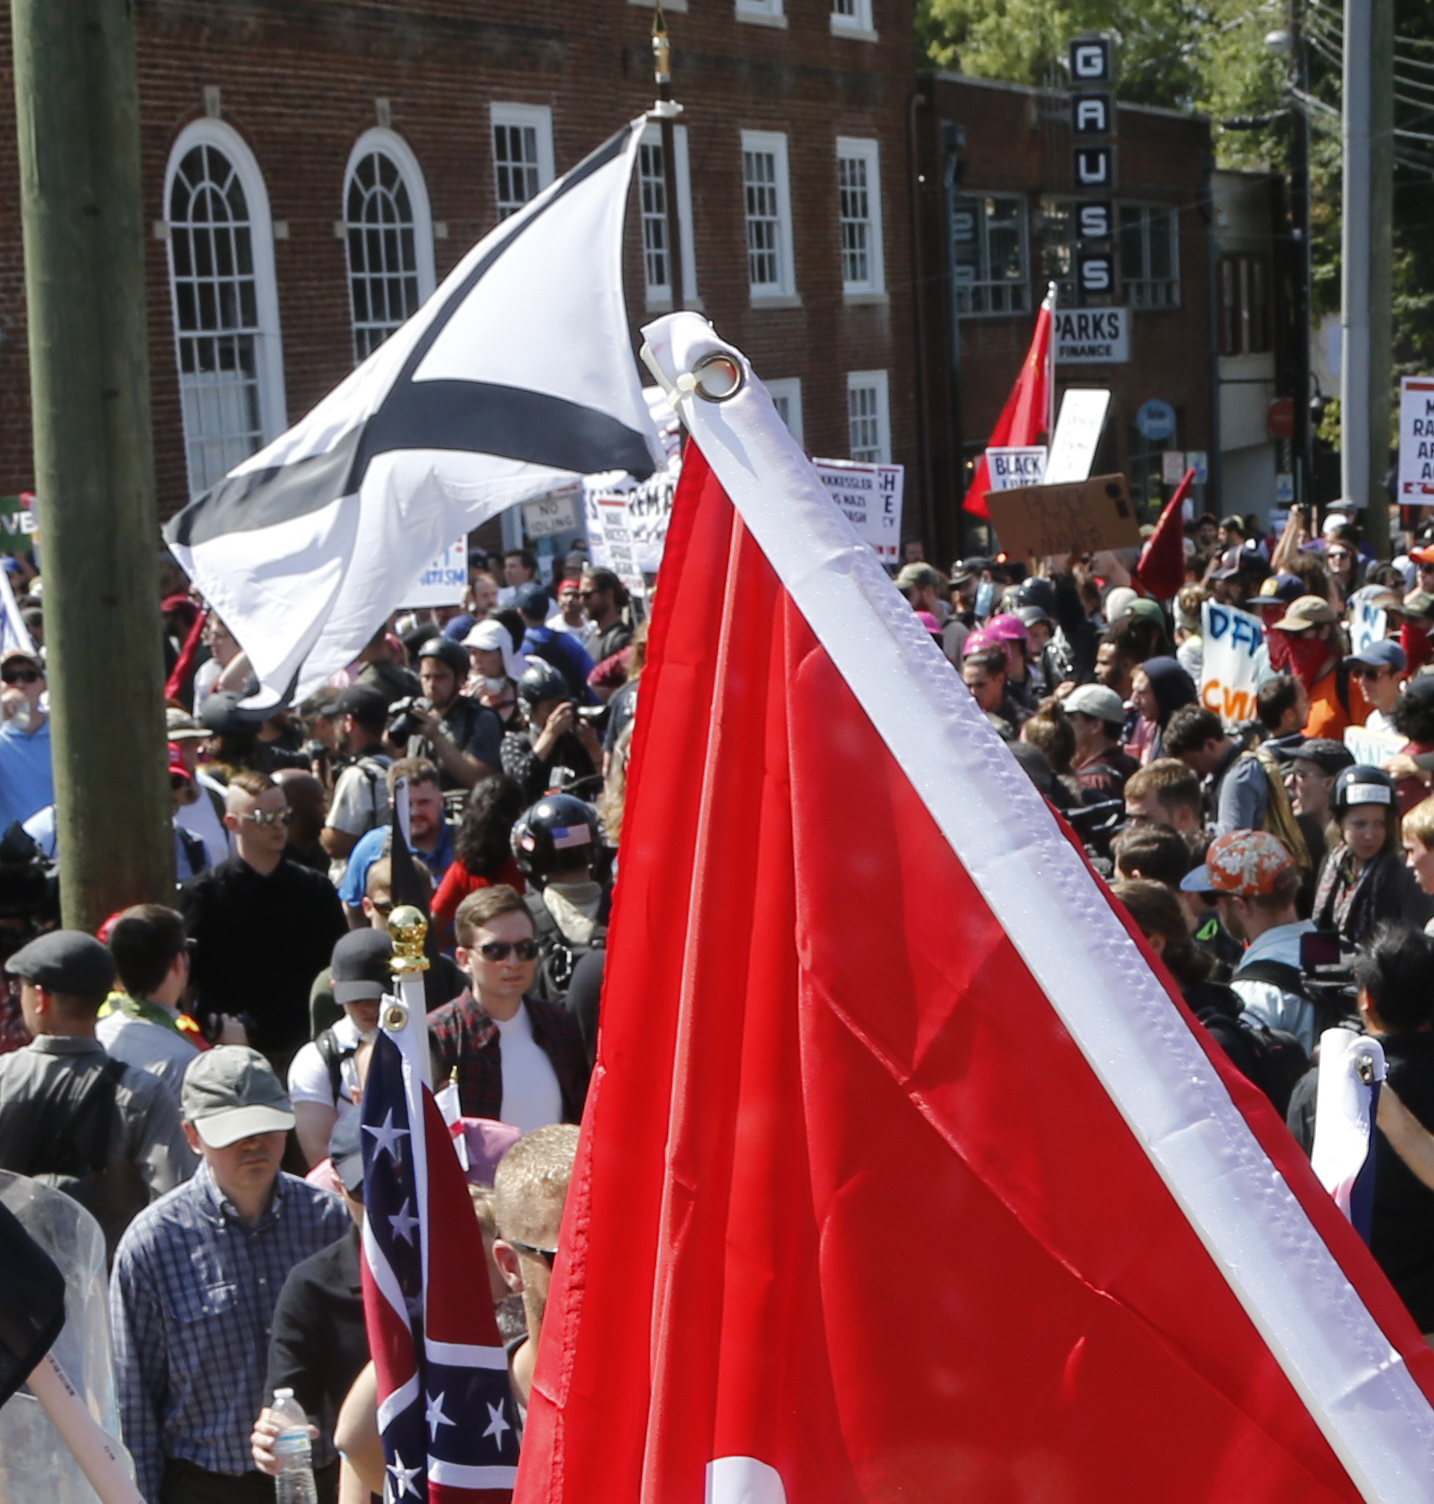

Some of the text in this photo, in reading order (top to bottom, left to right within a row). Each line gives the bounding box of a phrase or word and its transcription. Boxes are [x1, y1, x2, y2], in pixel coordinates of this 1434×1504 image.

[1075, 45, 1109, 290] GAUSS
[1058, 345, 1113, 358] FINANCE
[995, 455, 1042, 476] BLACK
[539, 499, 559, 516] NO
